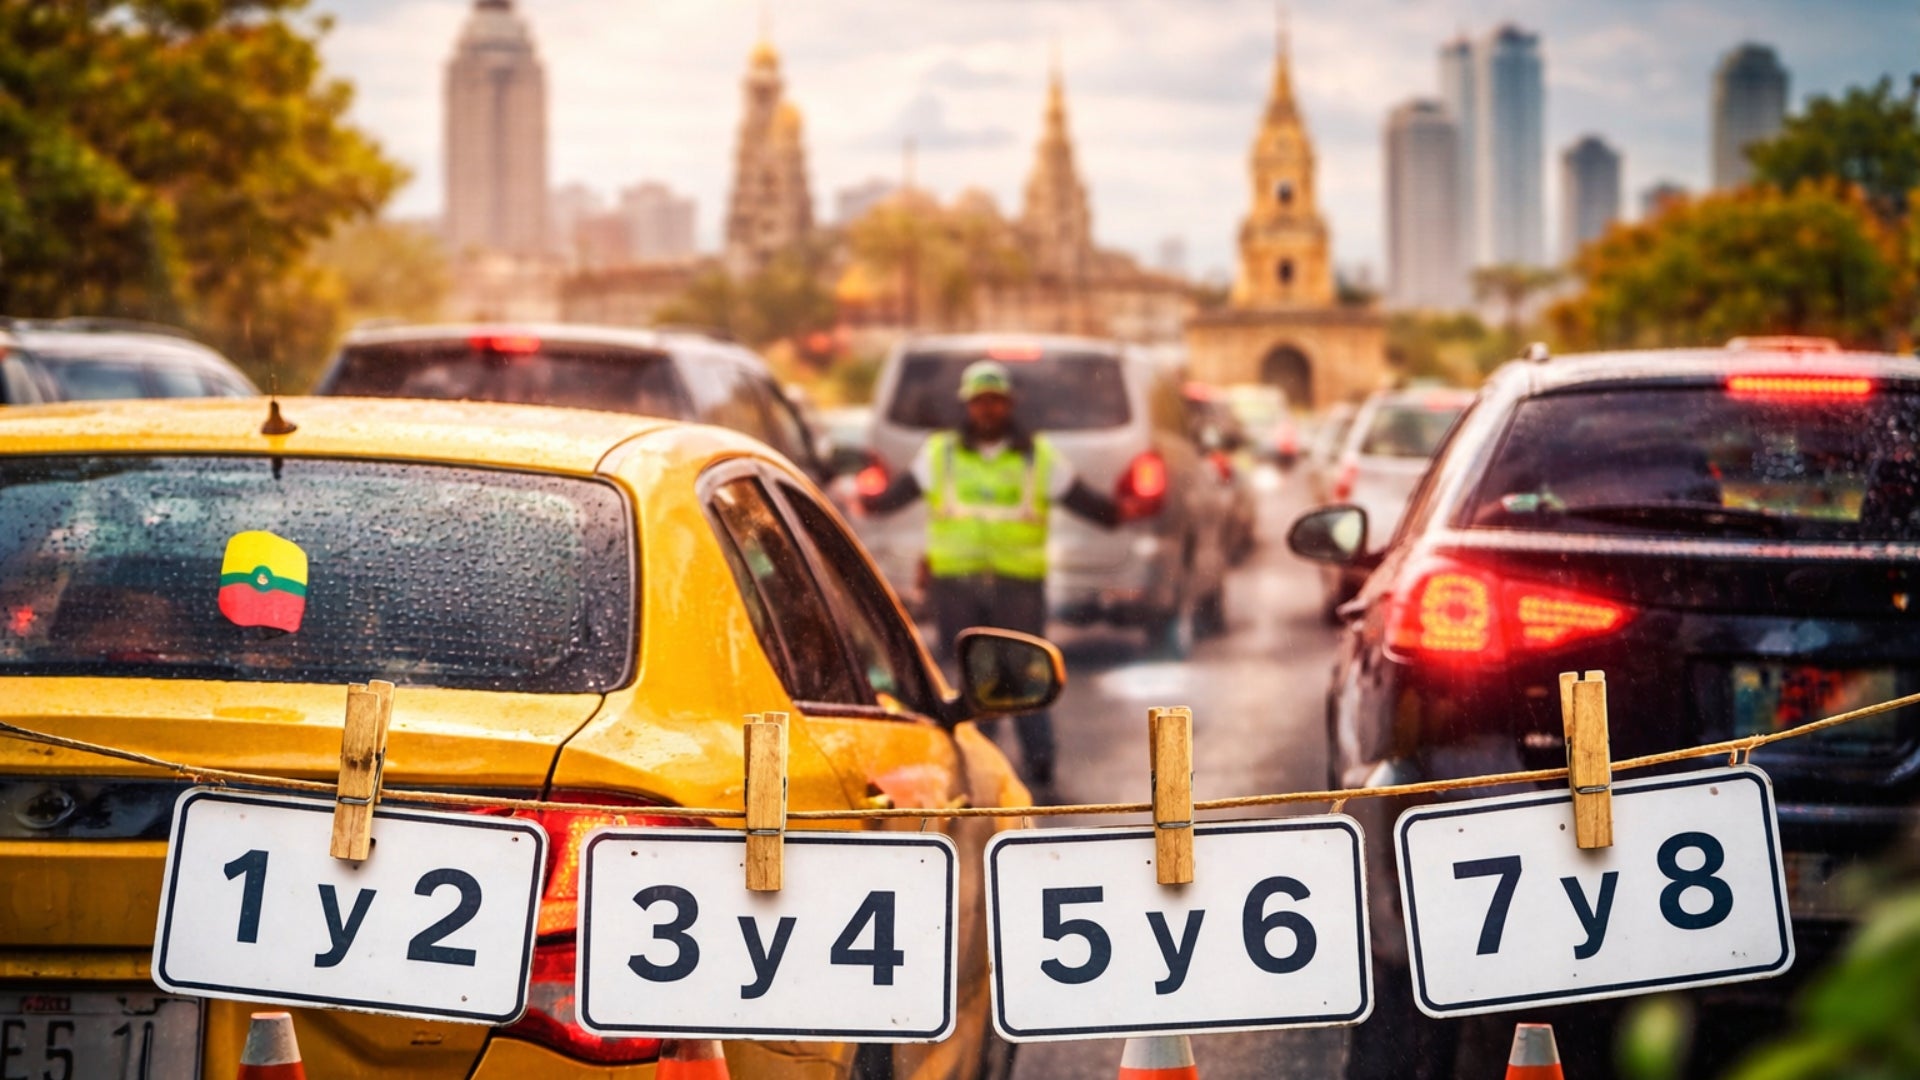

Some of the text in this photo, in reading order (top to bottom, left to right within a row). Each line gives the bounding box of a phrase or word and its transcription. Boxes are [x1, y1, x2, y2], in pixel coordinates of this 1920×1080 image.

[223, 849, 482, 968] 1 y 2
[627, 884, 904, 1000] 3 y 4
[1040, 876, 1317, 995] 5 y 6
[1452, 831, 1734, 960] 7 y 8
